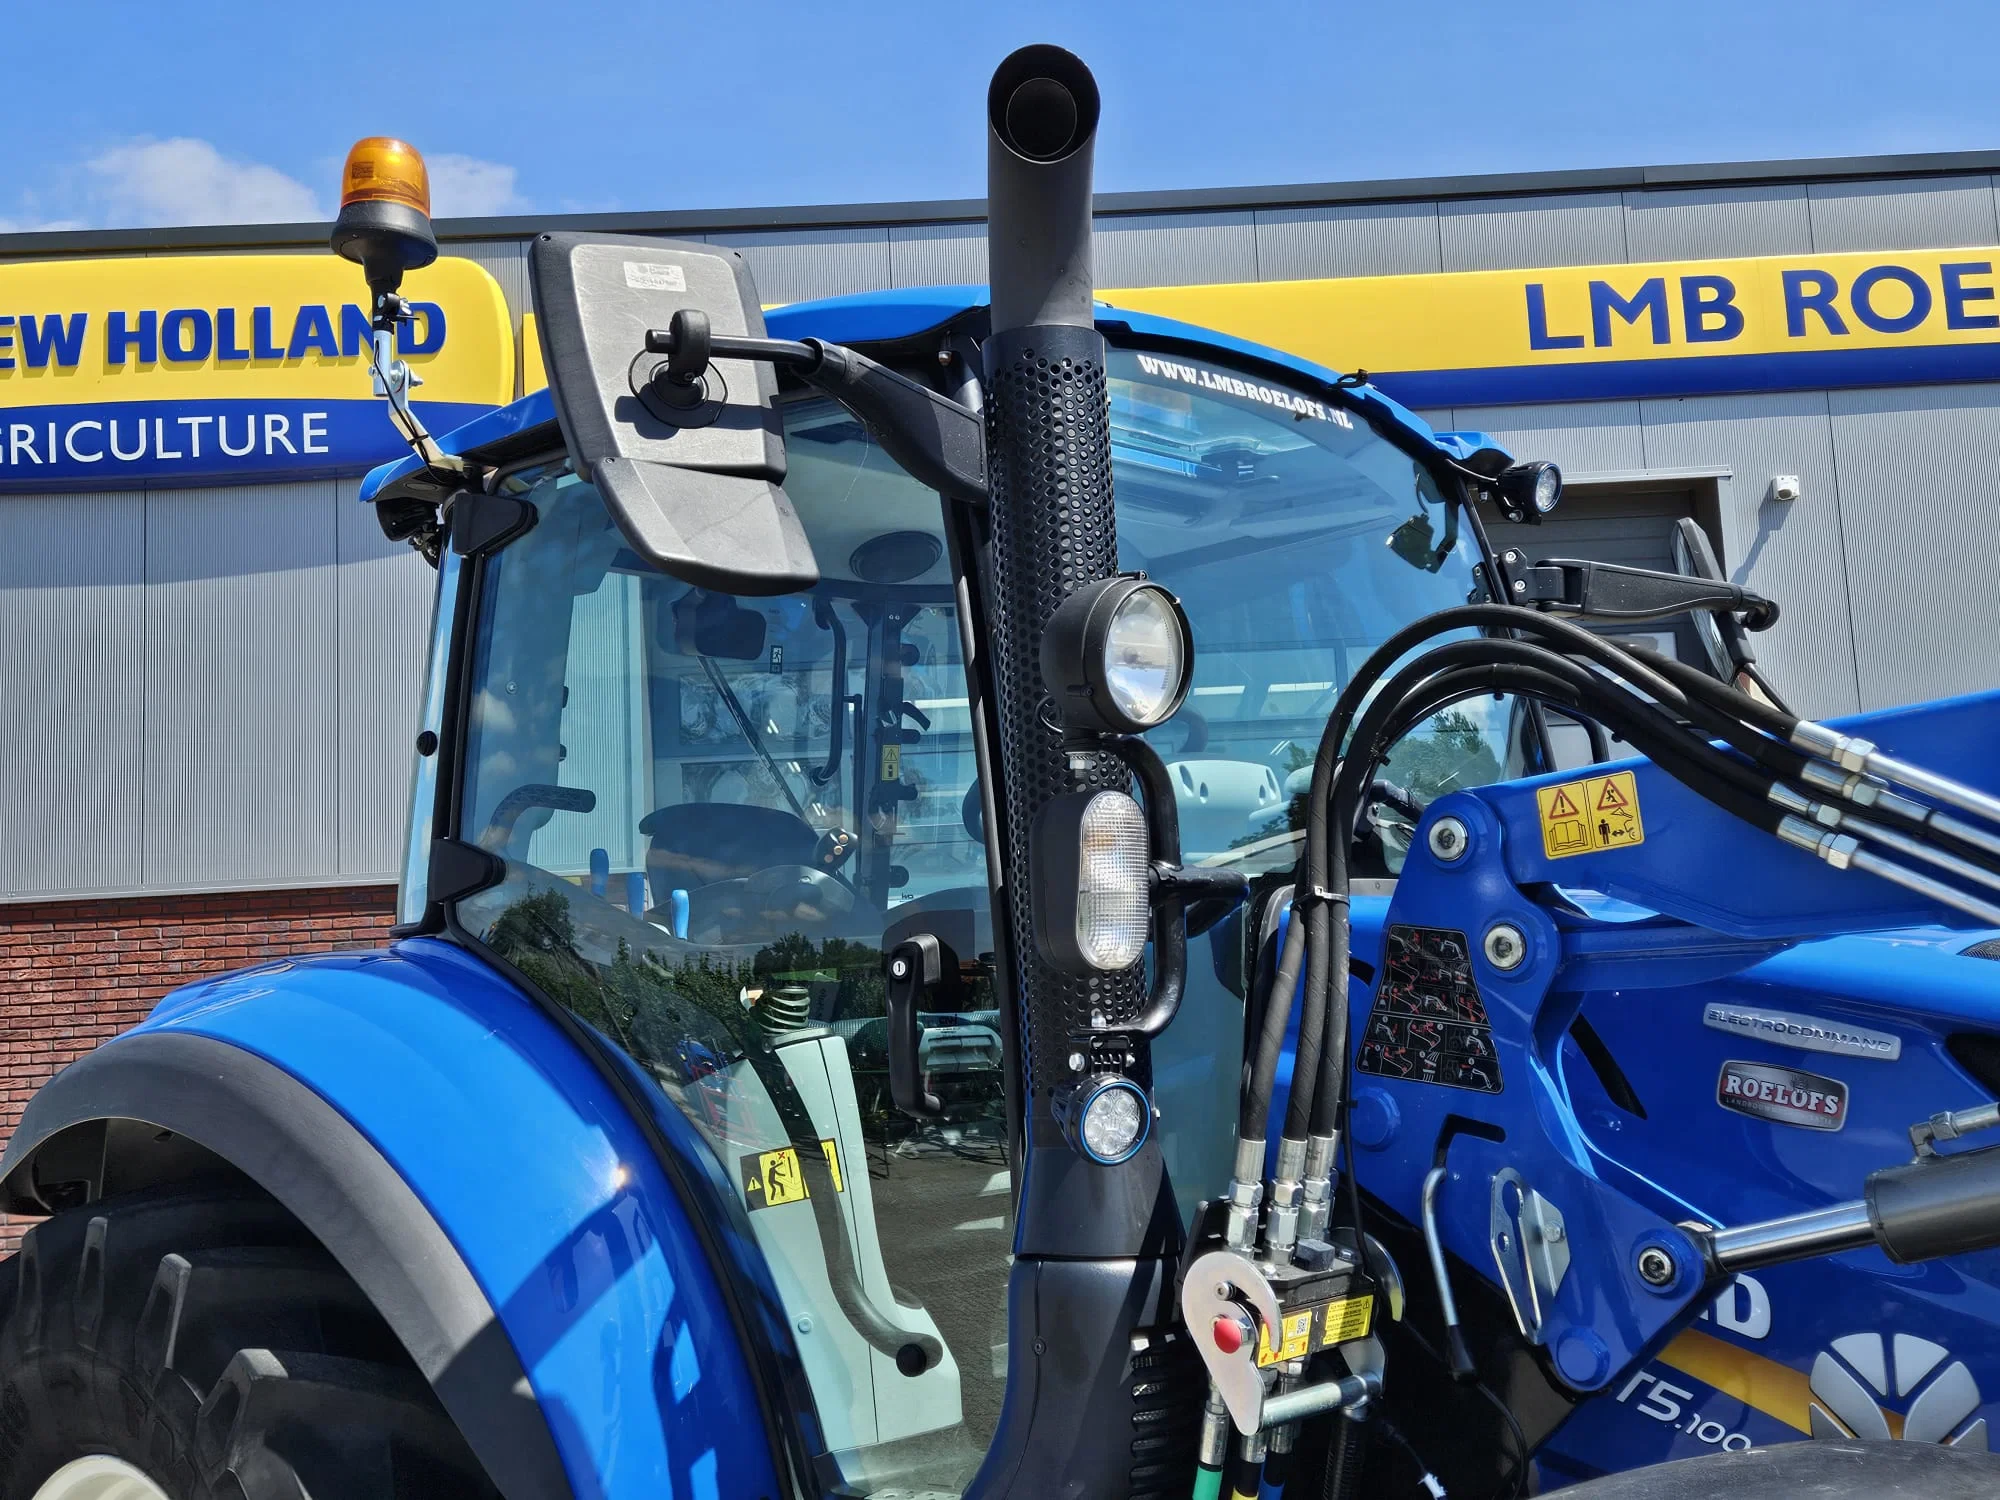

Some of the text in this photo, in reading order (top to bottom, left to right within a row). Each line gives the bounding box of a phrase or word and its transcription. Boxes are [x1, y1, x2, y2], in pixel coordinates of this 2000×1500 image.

[107, 301, 447, 364] HOLLAND
[1525, 262, 2000, 350] LMB ROE
[1137, 354, 1354, 430] WWW.LMBROELOFS.NL
[0, 412, 329, 466] RICULTURE
[1707, 1009, 1892, 1053] ELECTROCOMMAND
[1724, 1073, 1839, 1115] ROELOFS
